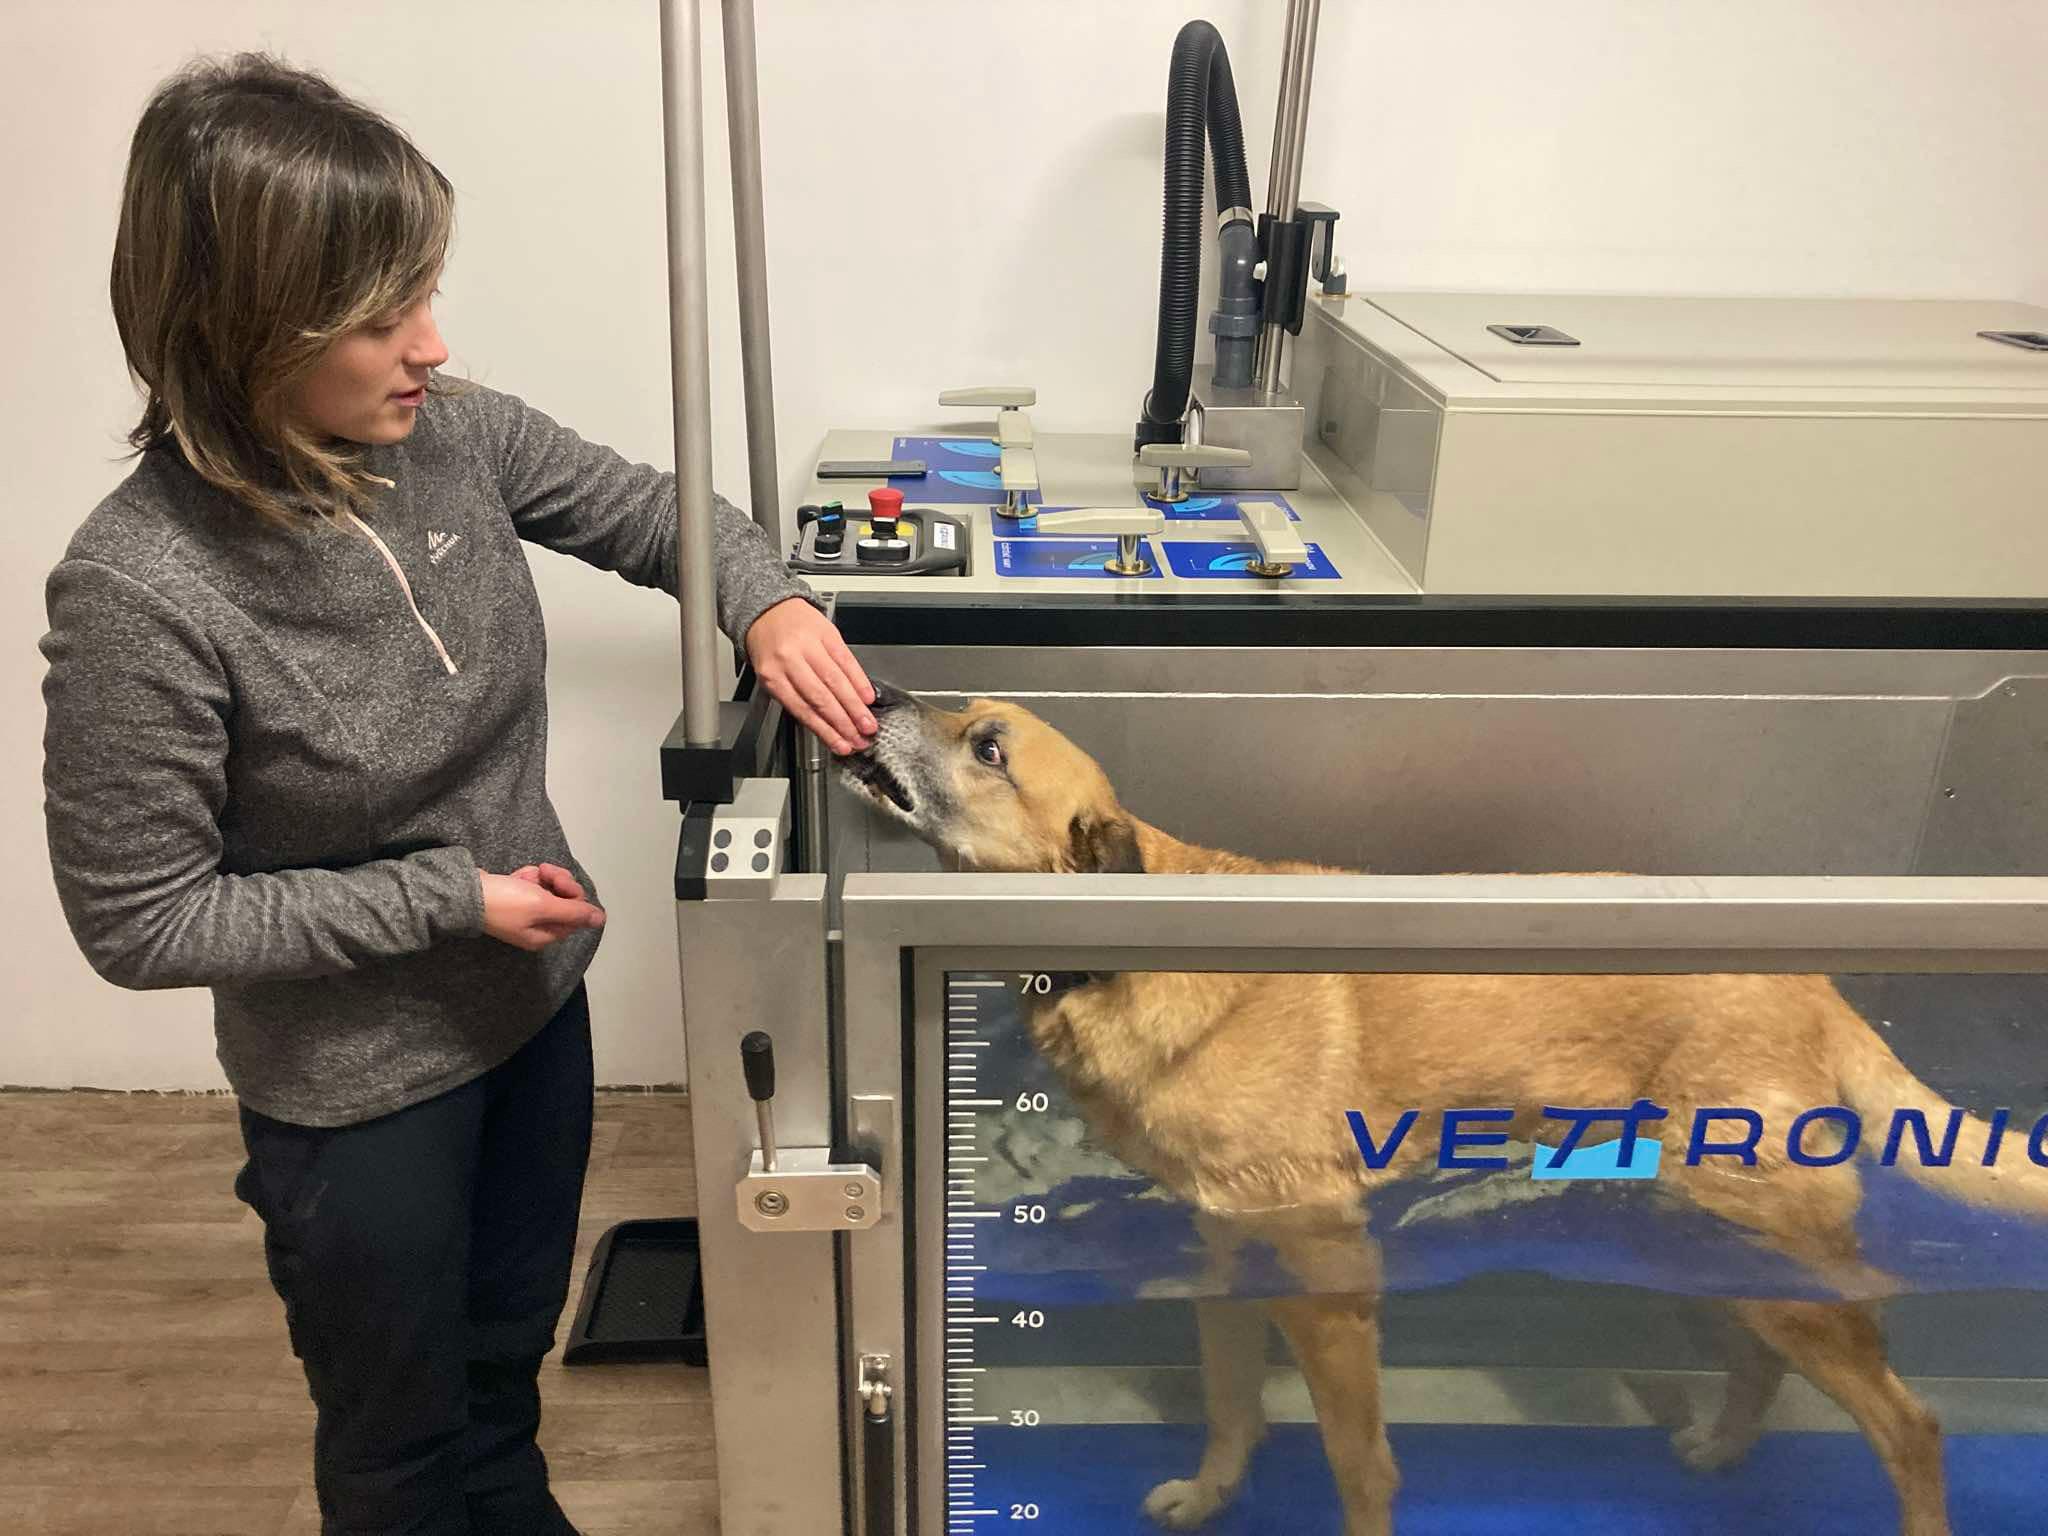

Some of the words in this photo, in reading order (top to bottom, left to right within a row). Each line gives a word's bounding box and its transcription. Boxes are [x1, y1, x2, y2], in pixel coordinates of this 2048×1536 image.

[1018, 973, 1052, 995] 70
[1015, 1092, 1049, 1112] 60
[1345, 1099, 2048, 1169] VETTRONI
[1013, 1205, 1046, 1225] 50
[1011, 1310, 1045, 1329] 40
[1009, 1409, 1041, 1428] 30
[1009, 1502, 1040, 1521] 20
